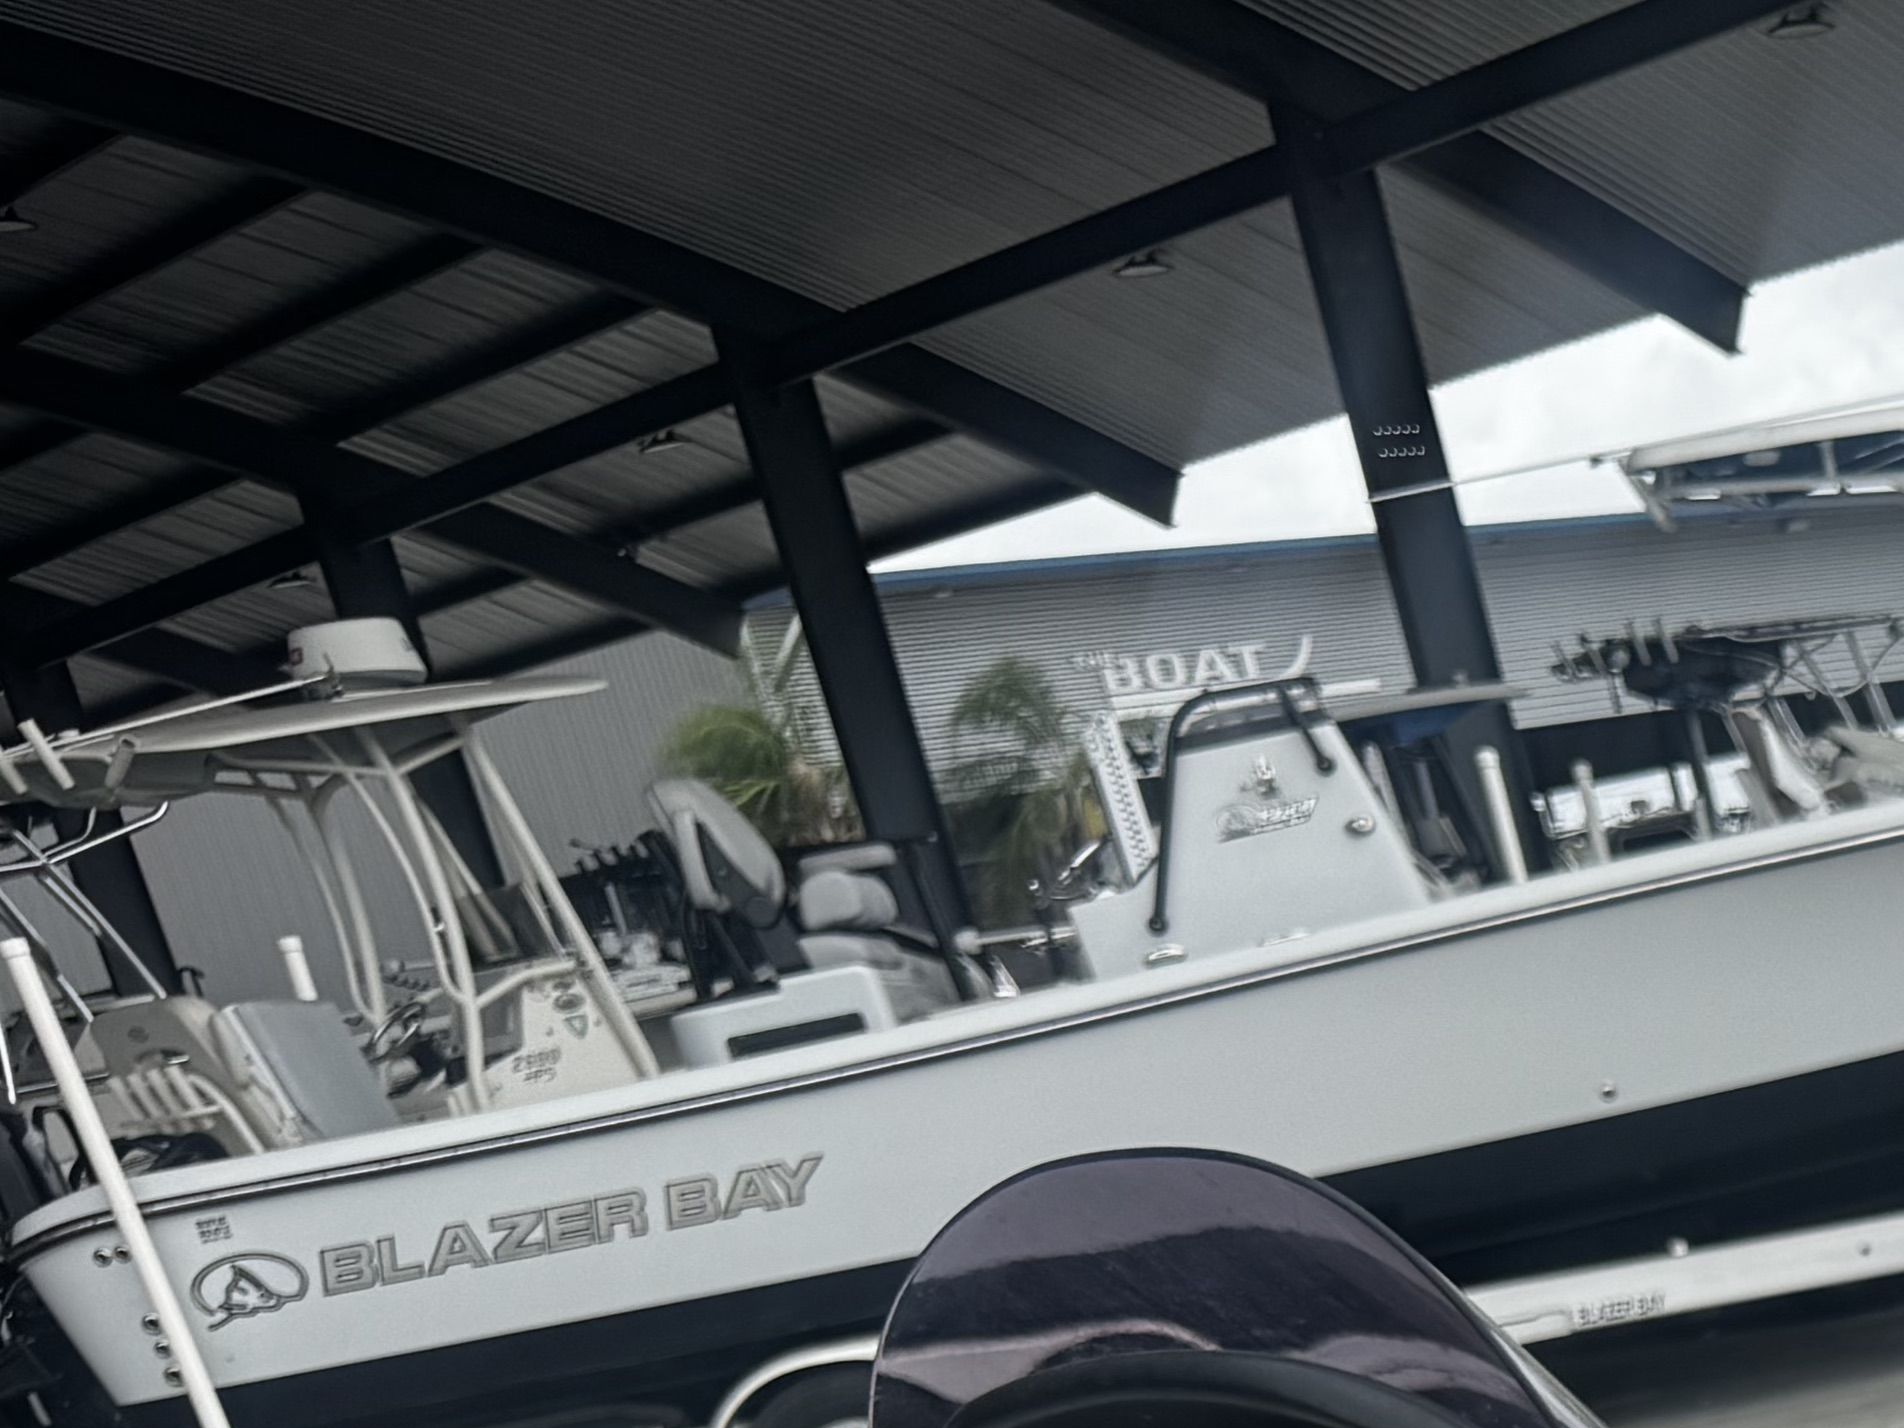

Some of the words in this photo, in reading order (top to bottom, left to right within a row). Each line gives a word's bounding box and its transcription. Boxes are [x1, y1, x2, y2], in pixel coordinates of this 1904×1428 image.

[1103, 640, 1267, 692] BOAT
[318, 1186, 649, 1297] BLAZER
[663, 1152, 824, 1231] BAY
